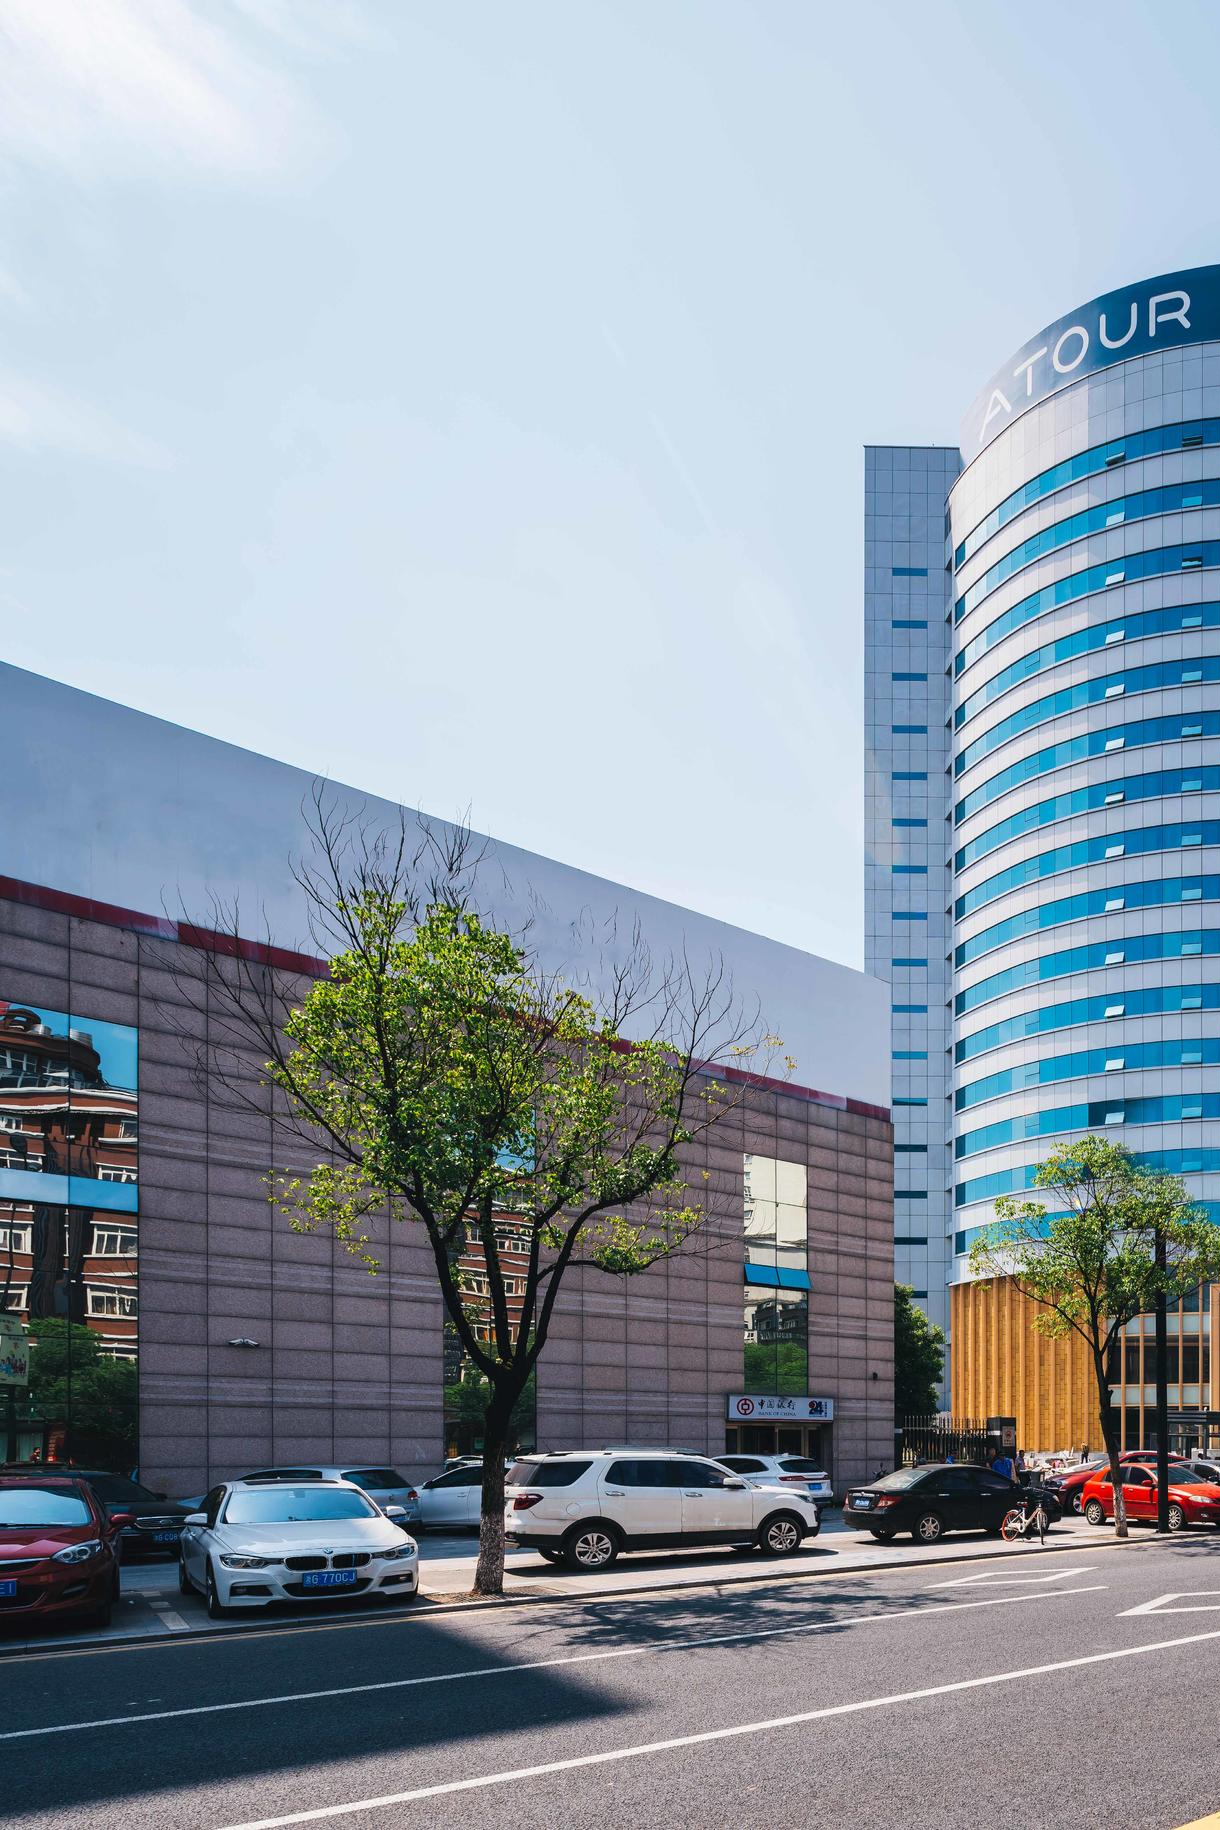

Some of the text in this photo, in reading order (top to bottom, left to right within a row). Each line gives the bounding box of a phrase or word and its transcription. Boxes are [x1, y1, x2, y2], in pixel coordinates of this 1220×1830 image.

[980, 290, 1191, 442] ATOUR
[758, 1399, 797, 1410] 中国银行
